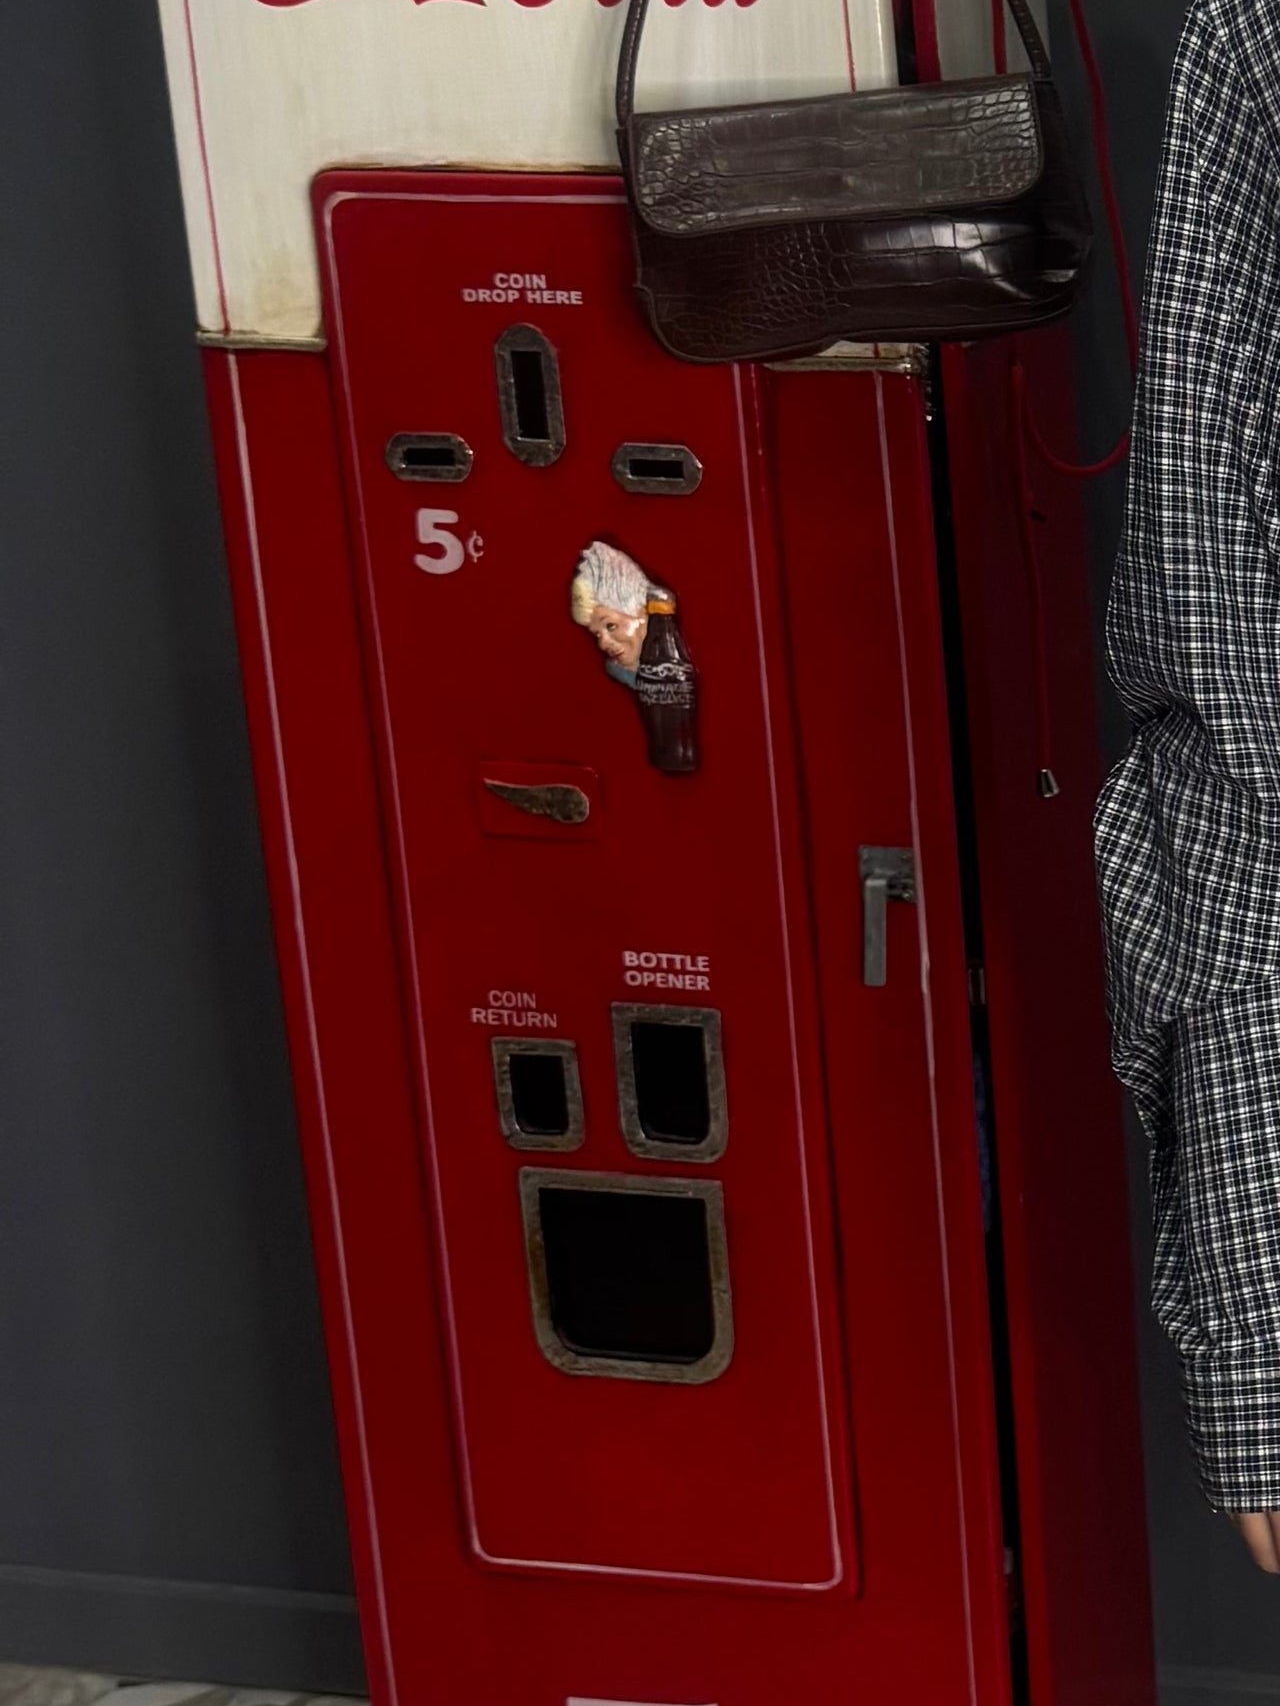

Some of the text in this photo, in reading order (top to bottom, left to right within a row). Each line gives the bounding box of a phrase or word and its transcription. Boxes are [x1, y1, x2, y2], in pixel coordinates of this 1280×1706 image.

[494, 273, 547, 289] COIN
[462, 288, 583, 304] DROP HERE
[413, 507, 485, 575] 5¢
[623, 951, 710, 972] BOTTLE
[624, 971, 710, 991] OPENER
[489, 990, 537, 1009] COIN
[471, 1007, 557, 1028] RETURN
